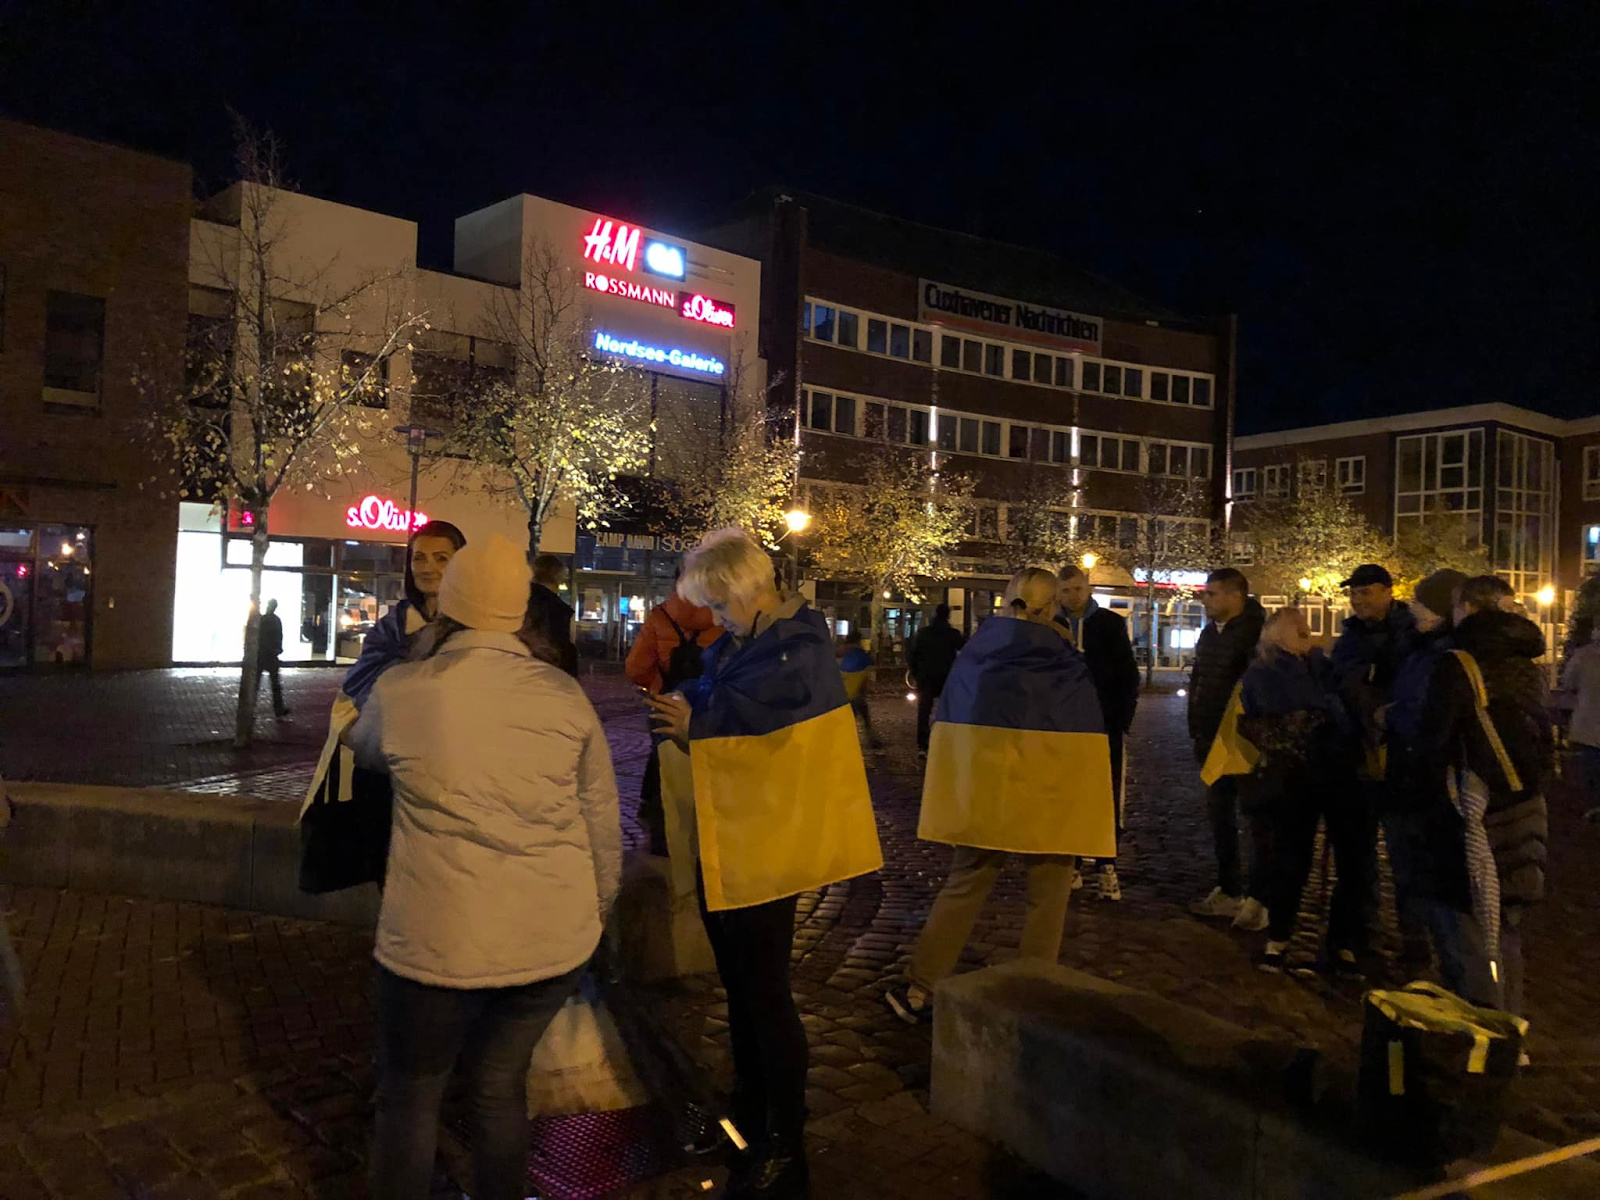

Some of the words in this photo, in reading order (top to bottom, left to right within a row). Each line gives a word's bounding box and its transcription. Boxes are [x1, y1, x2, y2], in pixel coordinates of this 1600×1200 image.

[584, 218, 640, 271] H&M
[585, 271, 675, 308] ROSSMANN
[925, 284, 1012, 324] Cuxhavener
[1016, 304, 1098, 341] Nachrichten
[596, 333, 724, 374] Nordsee-Galerie
